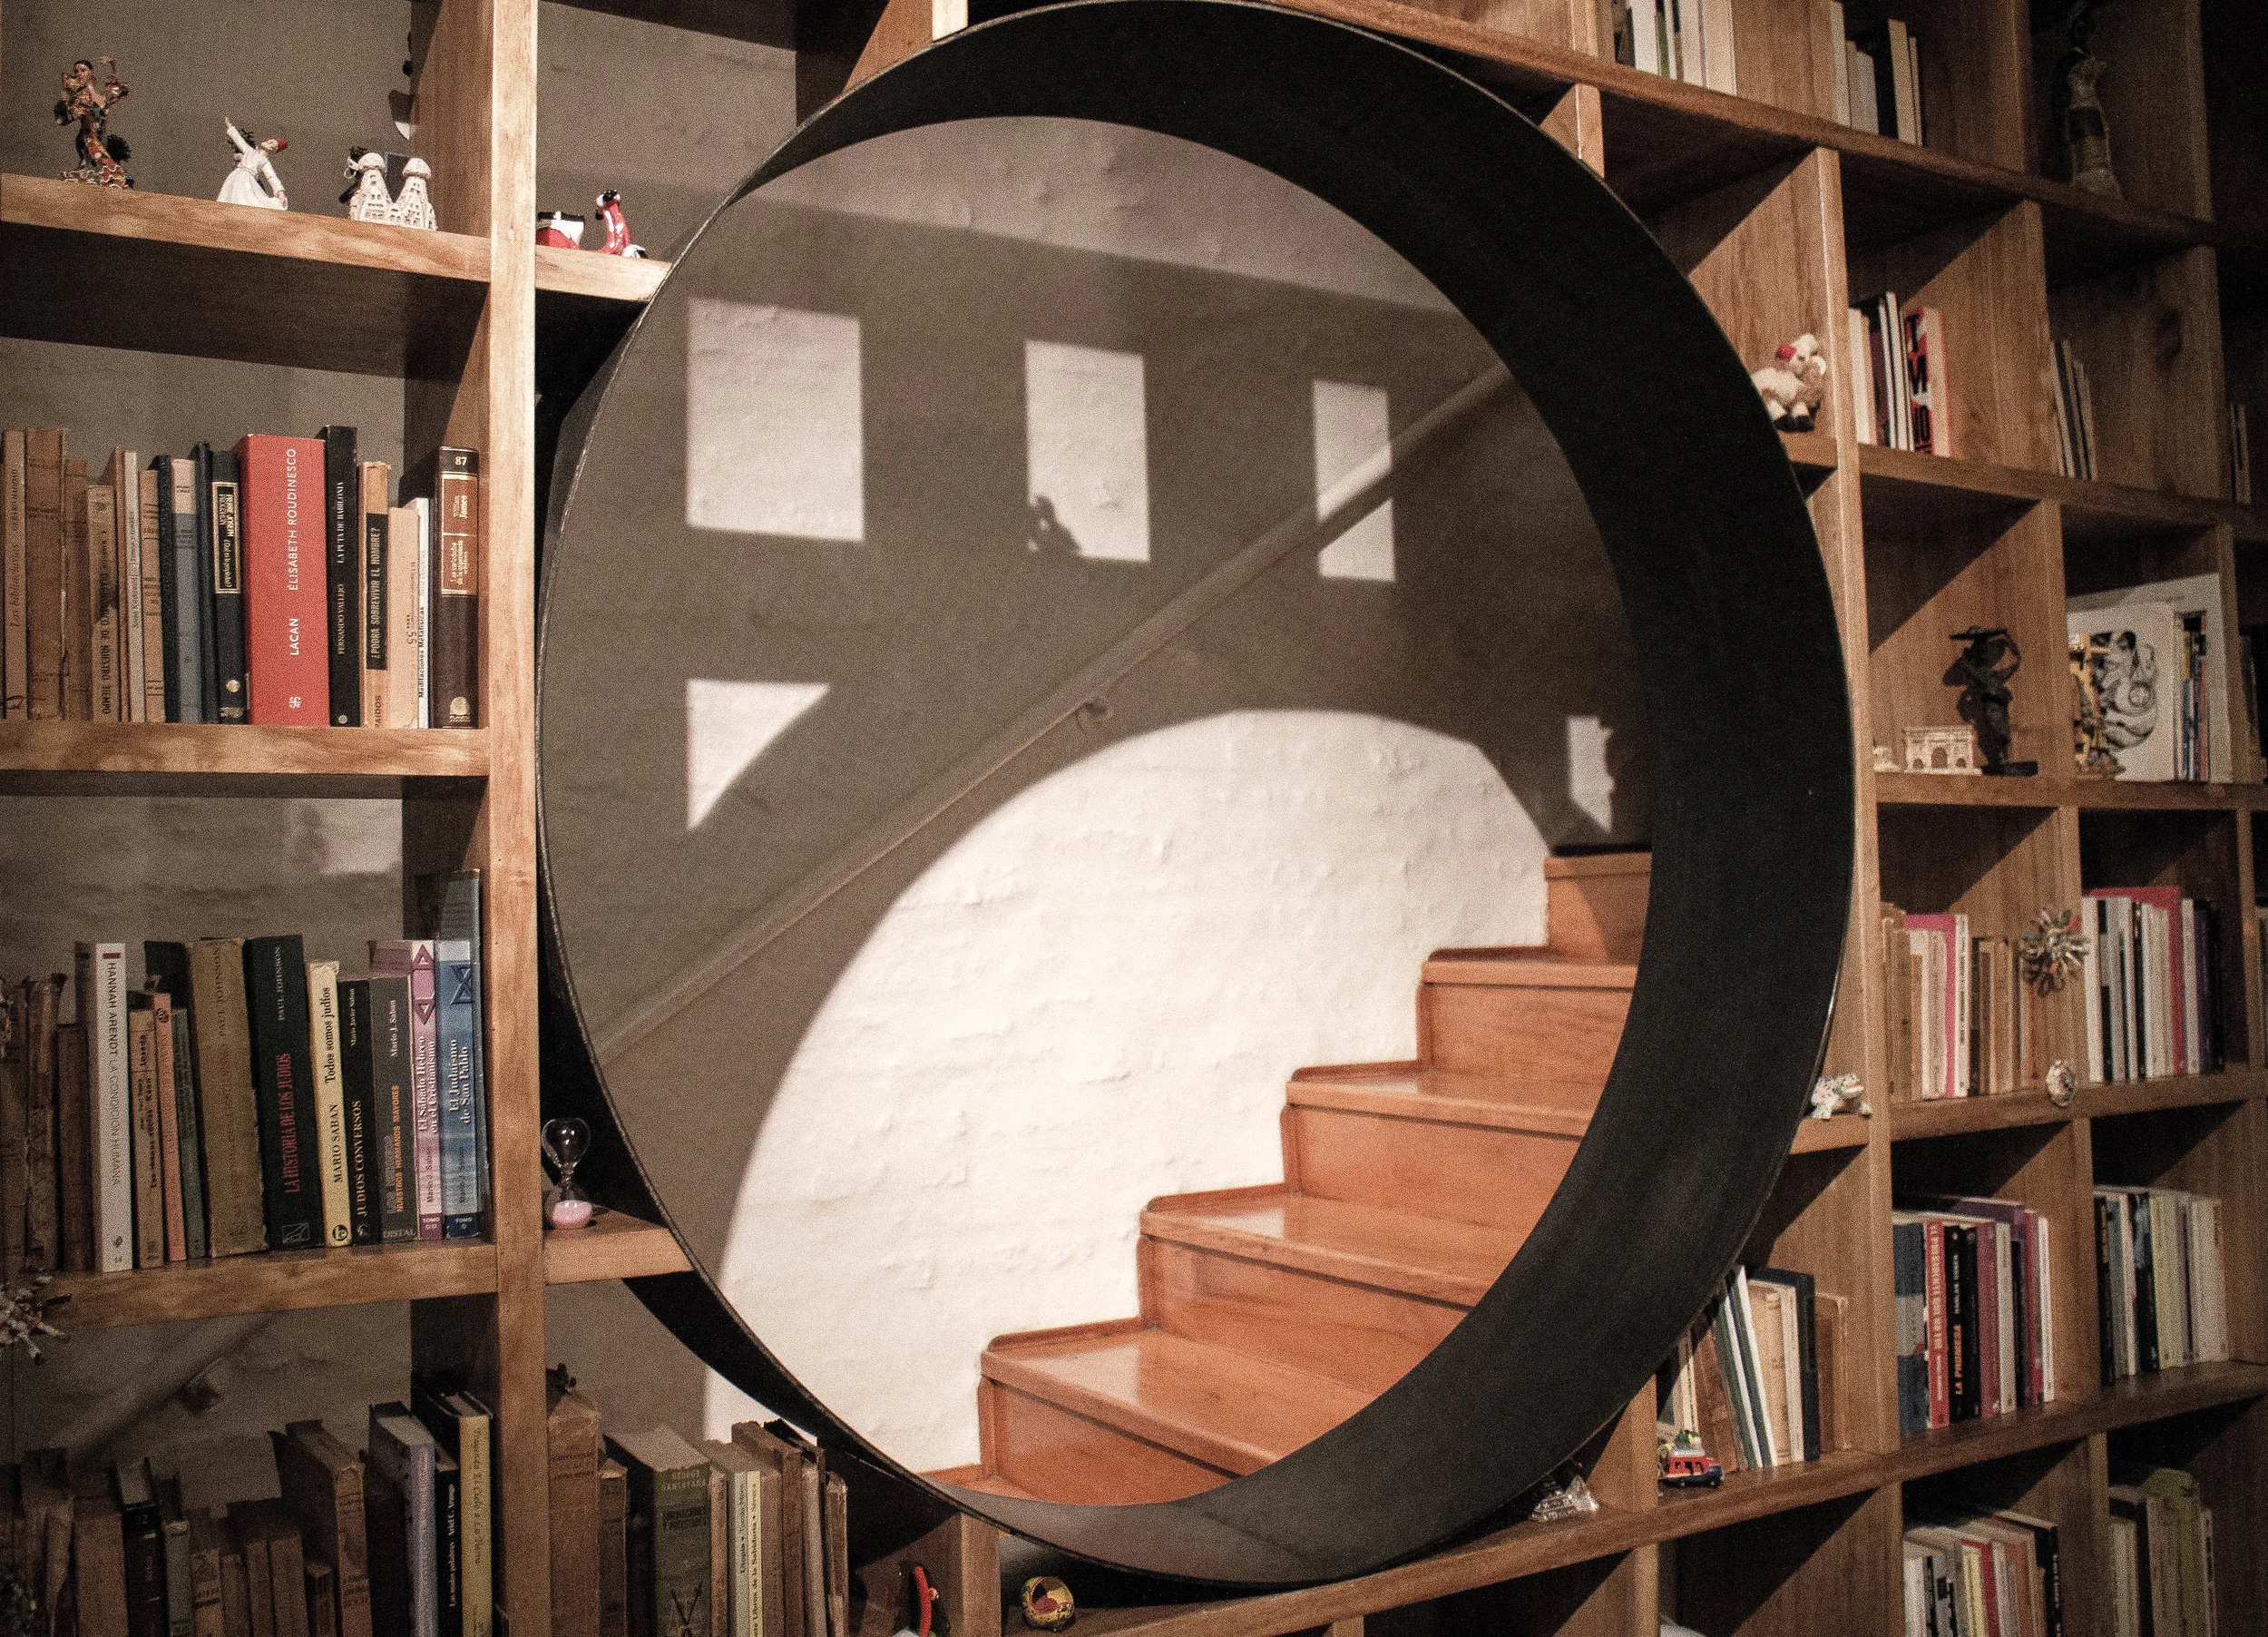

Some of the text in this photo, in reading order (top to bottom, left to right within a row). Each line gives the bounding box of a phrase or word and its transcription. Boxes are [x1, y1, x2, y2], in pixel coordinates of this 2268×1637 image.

[455, 456, 468, 466] 87
[286, 447, 298, 525] ROUDINESCO
[459, 495, 469, 520] James
[337, 521, 344, 533] DE
[337, 553, 344, 564] LA
[369, 526, 380, 564] HOMBRE?
[370, 566, 380, 577] EL
[289, 617, 299, 655] LACAN
[337, 583, 346, 655] FERNANDO VALLEJO
[100, 643, 111, 681] NUESTRO
[102, 684, 112, 715] TIEMPO
[106, 962, 119, 1009] HANNAH
[108, 1012, 121, 1056] ARENDT
[323, 1020, 335, 1051] somos
[388, 1032, 398, 1057] Mario
[323, 1052, 337, 1084] Todos
[279, 1111, 297, 1126] DE
[391, 1084, 401, 1122] MAYORES
[328, 1103, 343, 1183] MARIO SABAN
[351, 1099, 365, 1171] CONVERSOS
[281, 1129, 300, 1178] HISTORIA
[284, 1179, 301, 1193] LA
